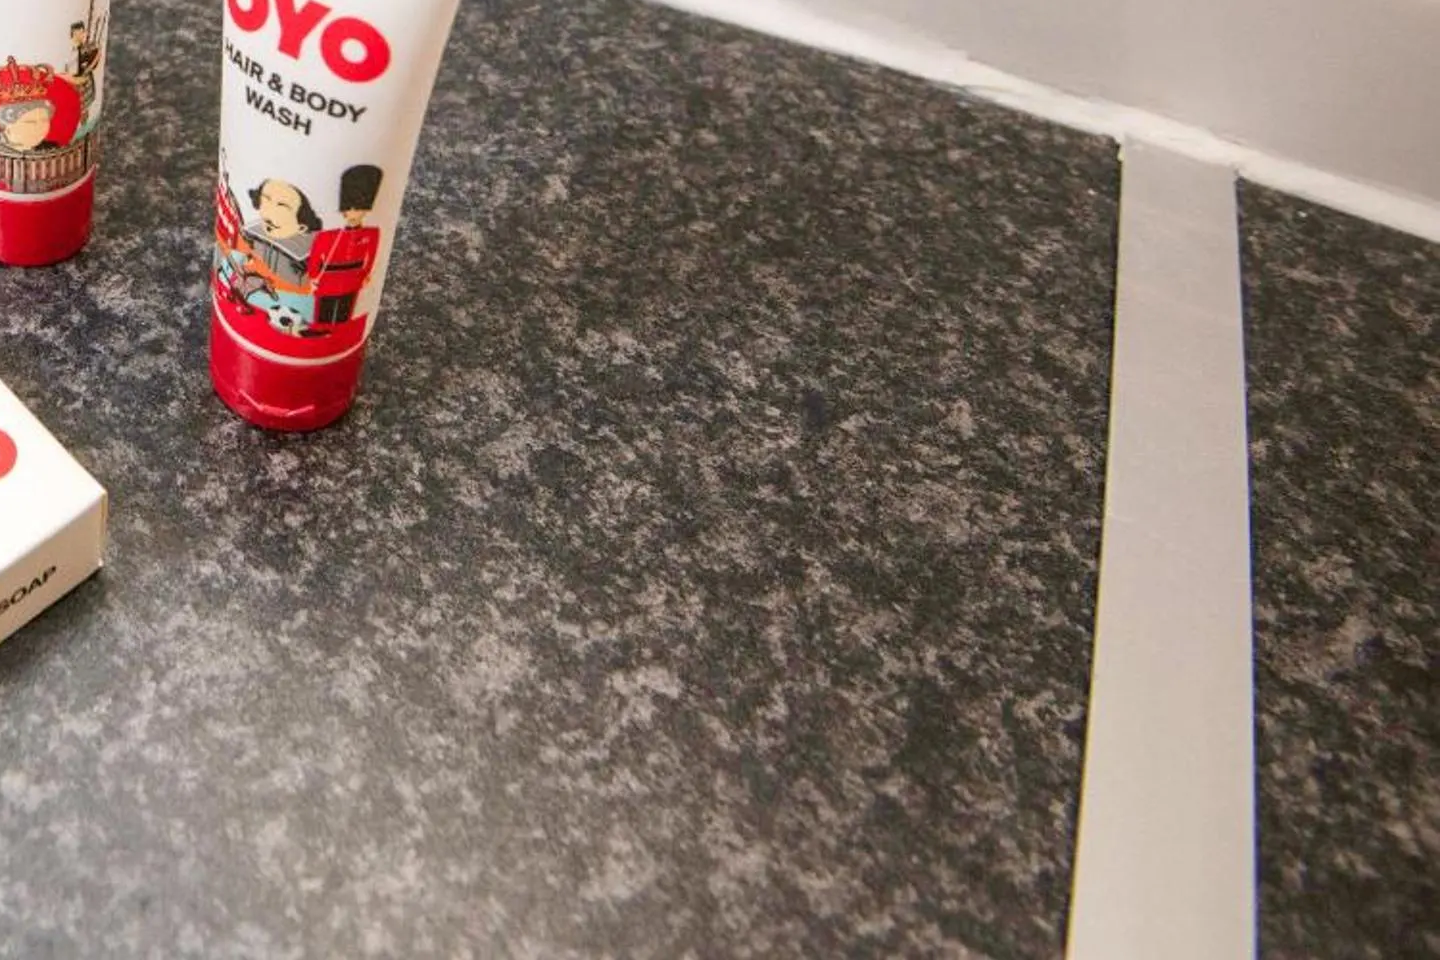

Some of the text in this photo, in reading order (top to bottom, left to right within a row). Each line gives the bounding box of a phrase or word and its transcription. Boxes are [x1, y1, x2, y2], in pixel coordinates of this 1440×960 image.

[224, 37, 368, 123] HAIR & BODY
[245, 86, 312, 136] WASH
